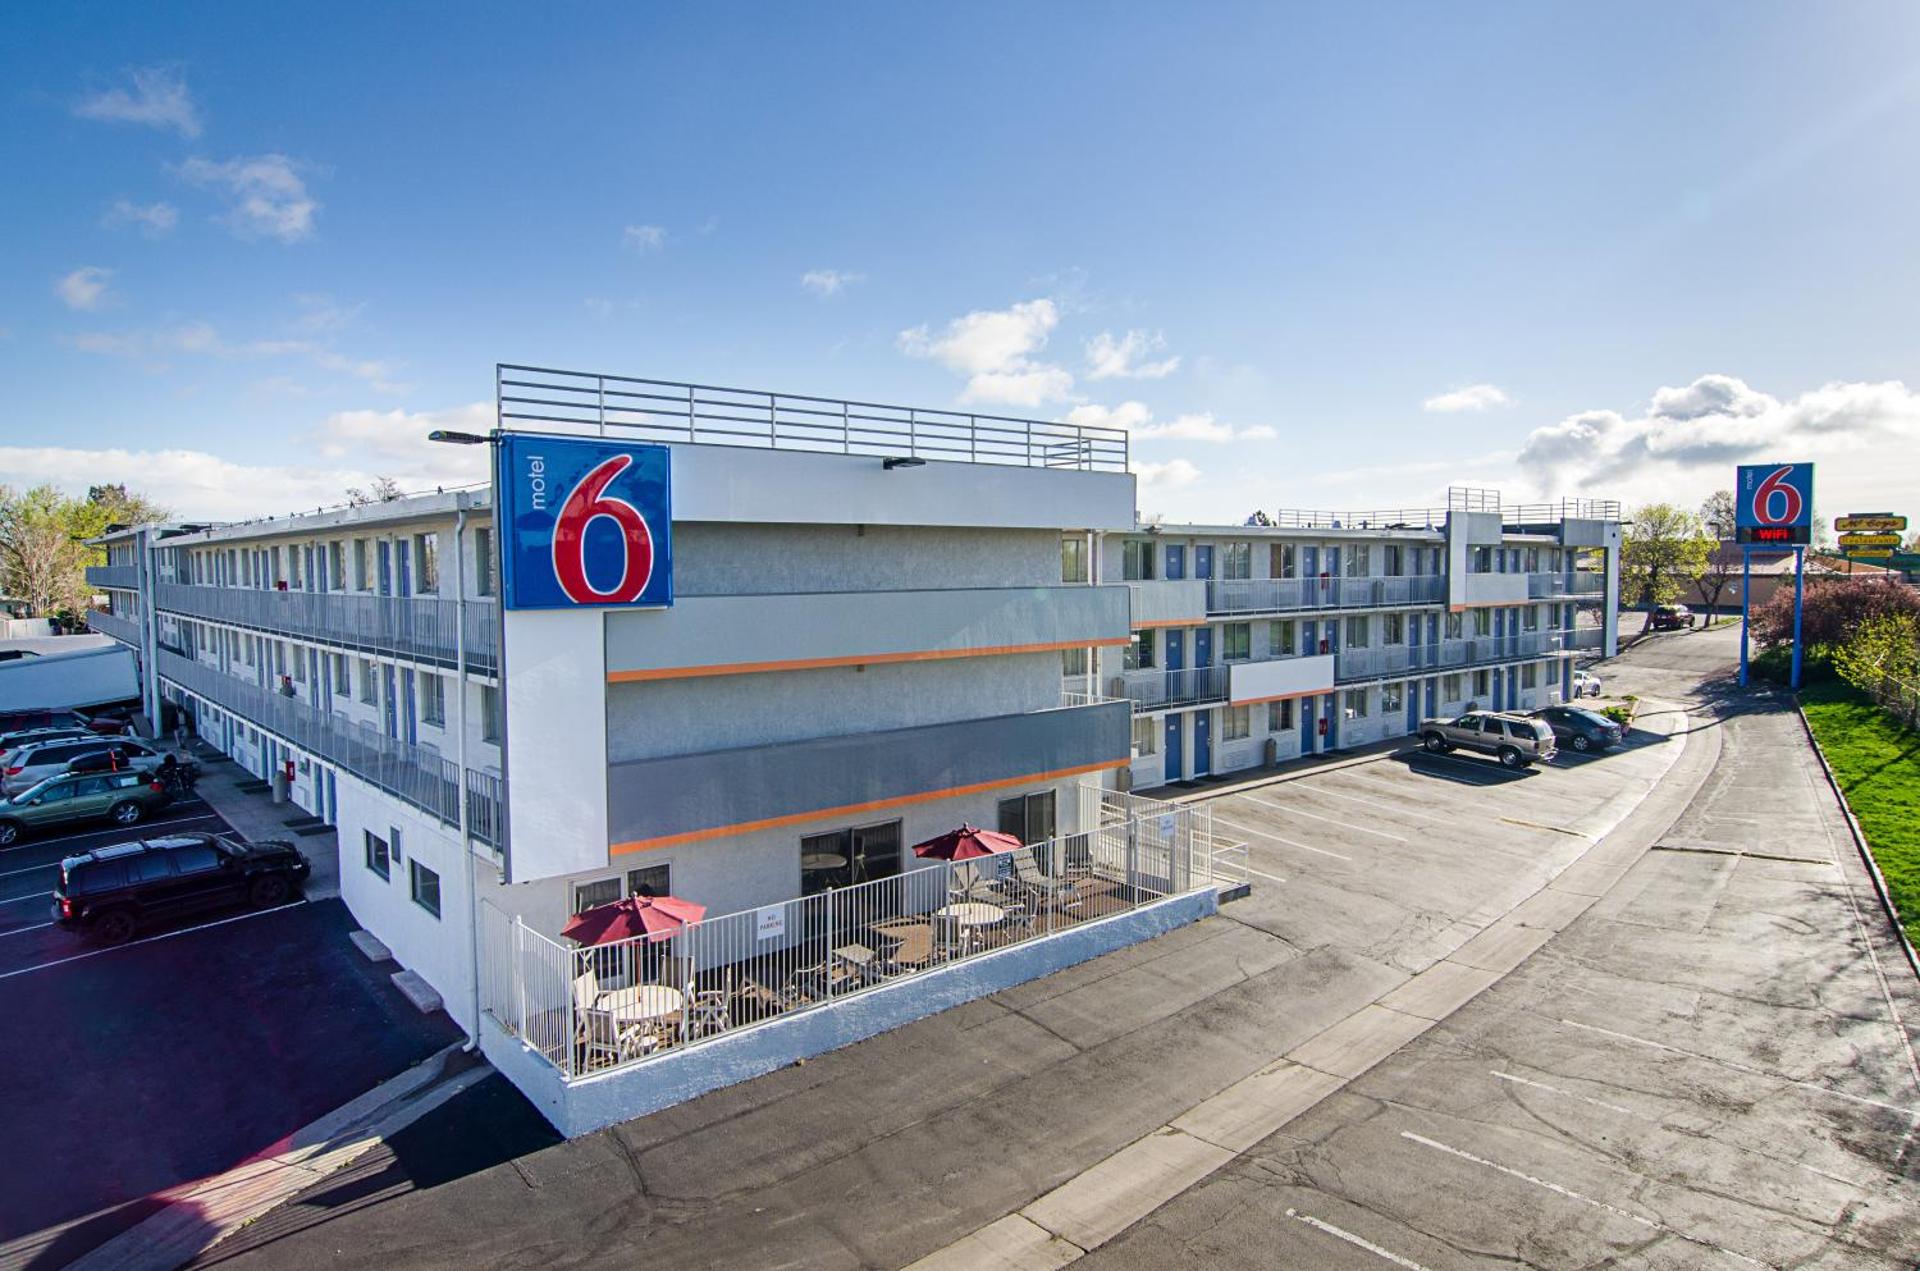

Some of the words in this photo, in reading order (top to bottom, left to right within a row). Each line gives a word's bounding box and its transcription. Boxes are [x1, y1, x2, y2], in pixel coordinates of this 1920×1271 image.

[528, 455, 546, 510] motel
[552, 454, 654, 604] 6
[1753, 466, 1802, 525] 6
